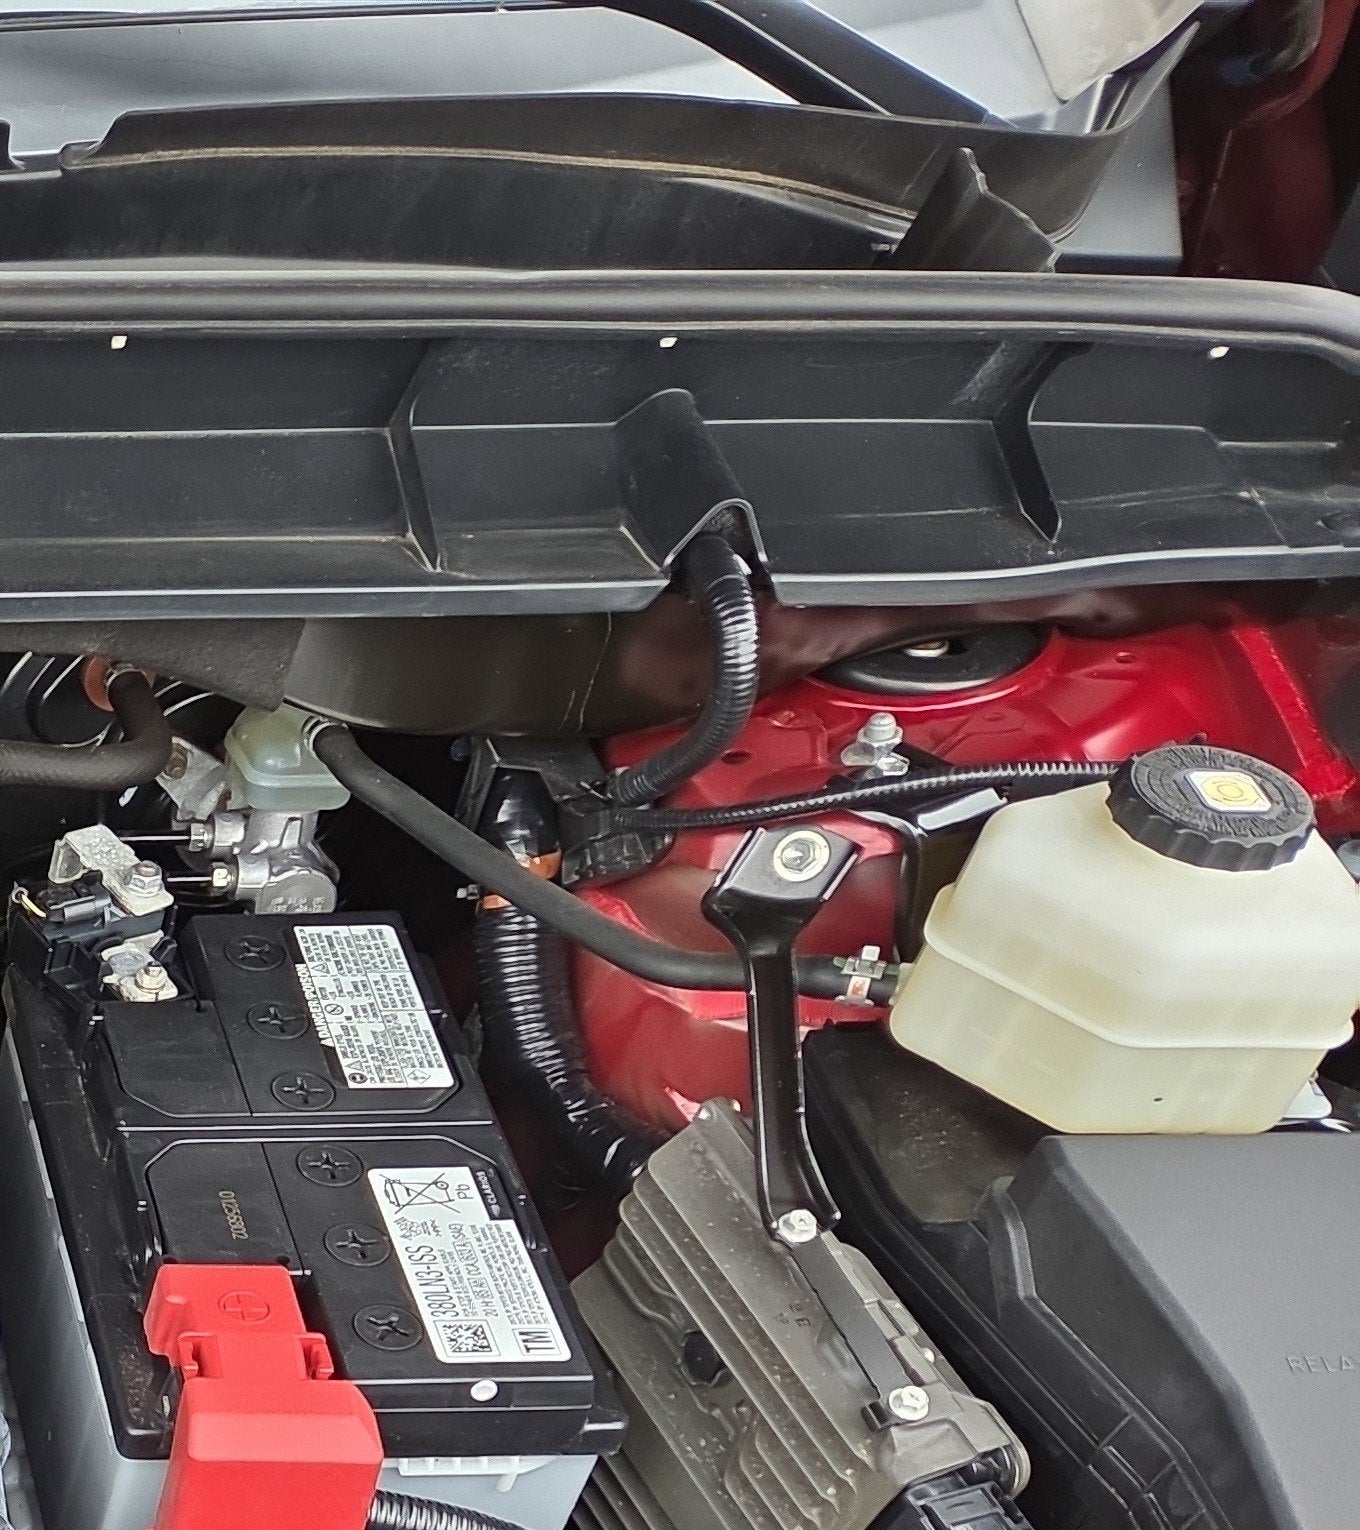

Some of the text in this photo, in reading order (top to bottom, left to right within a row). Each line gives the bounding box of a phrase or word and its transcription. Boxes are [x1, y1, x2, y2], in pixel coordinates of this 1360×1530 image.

[295, 963, 330, 1038] DANGER/POISON
[456, 1182, 475, 1201] Pb
[405, 1244, 459, 1318] 380LN3-ISS
[524, 1328, 551, 1354] TM
